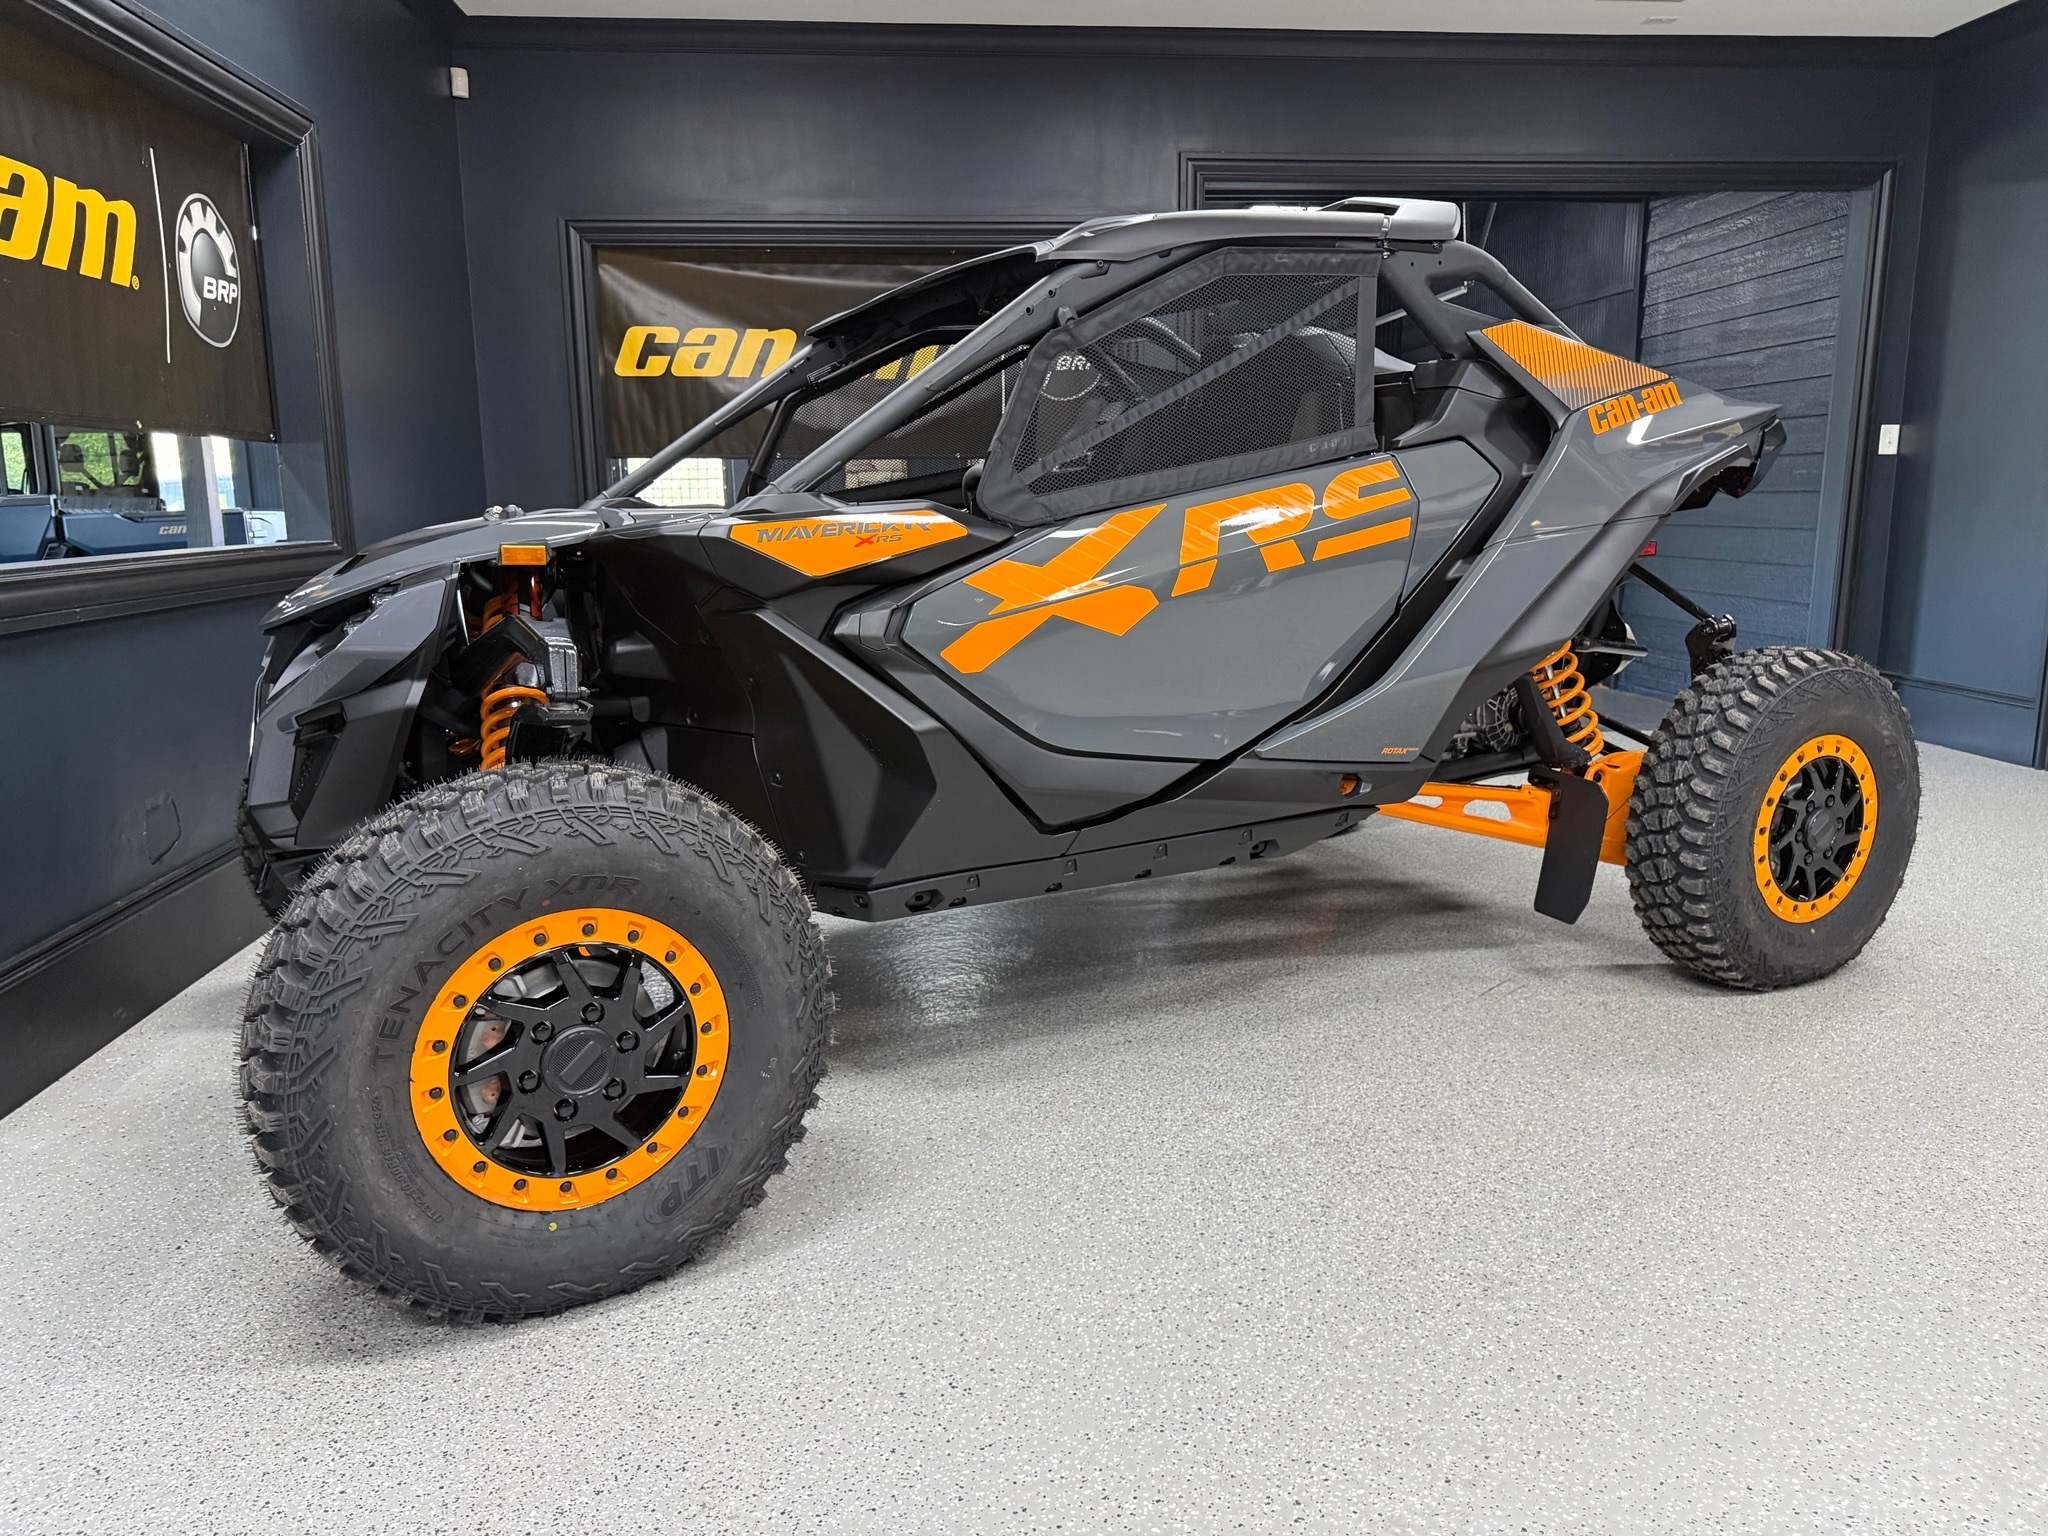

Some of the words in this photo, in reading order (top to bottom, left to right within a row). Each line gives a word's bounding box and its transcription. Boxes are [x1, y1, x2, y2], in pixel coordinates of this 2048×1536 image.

[203, 275, 238, 304] BRP
[1587, 381, 1683, 435] can-am
[757, 521, 900, 543] MAVERICK
[854, 533, 902, 547] XRS
[940, 460, 1411, 673] XRS
[370, 885, 530, 1070] TENACITY
[658, 1144, 720, 1219] ITP
